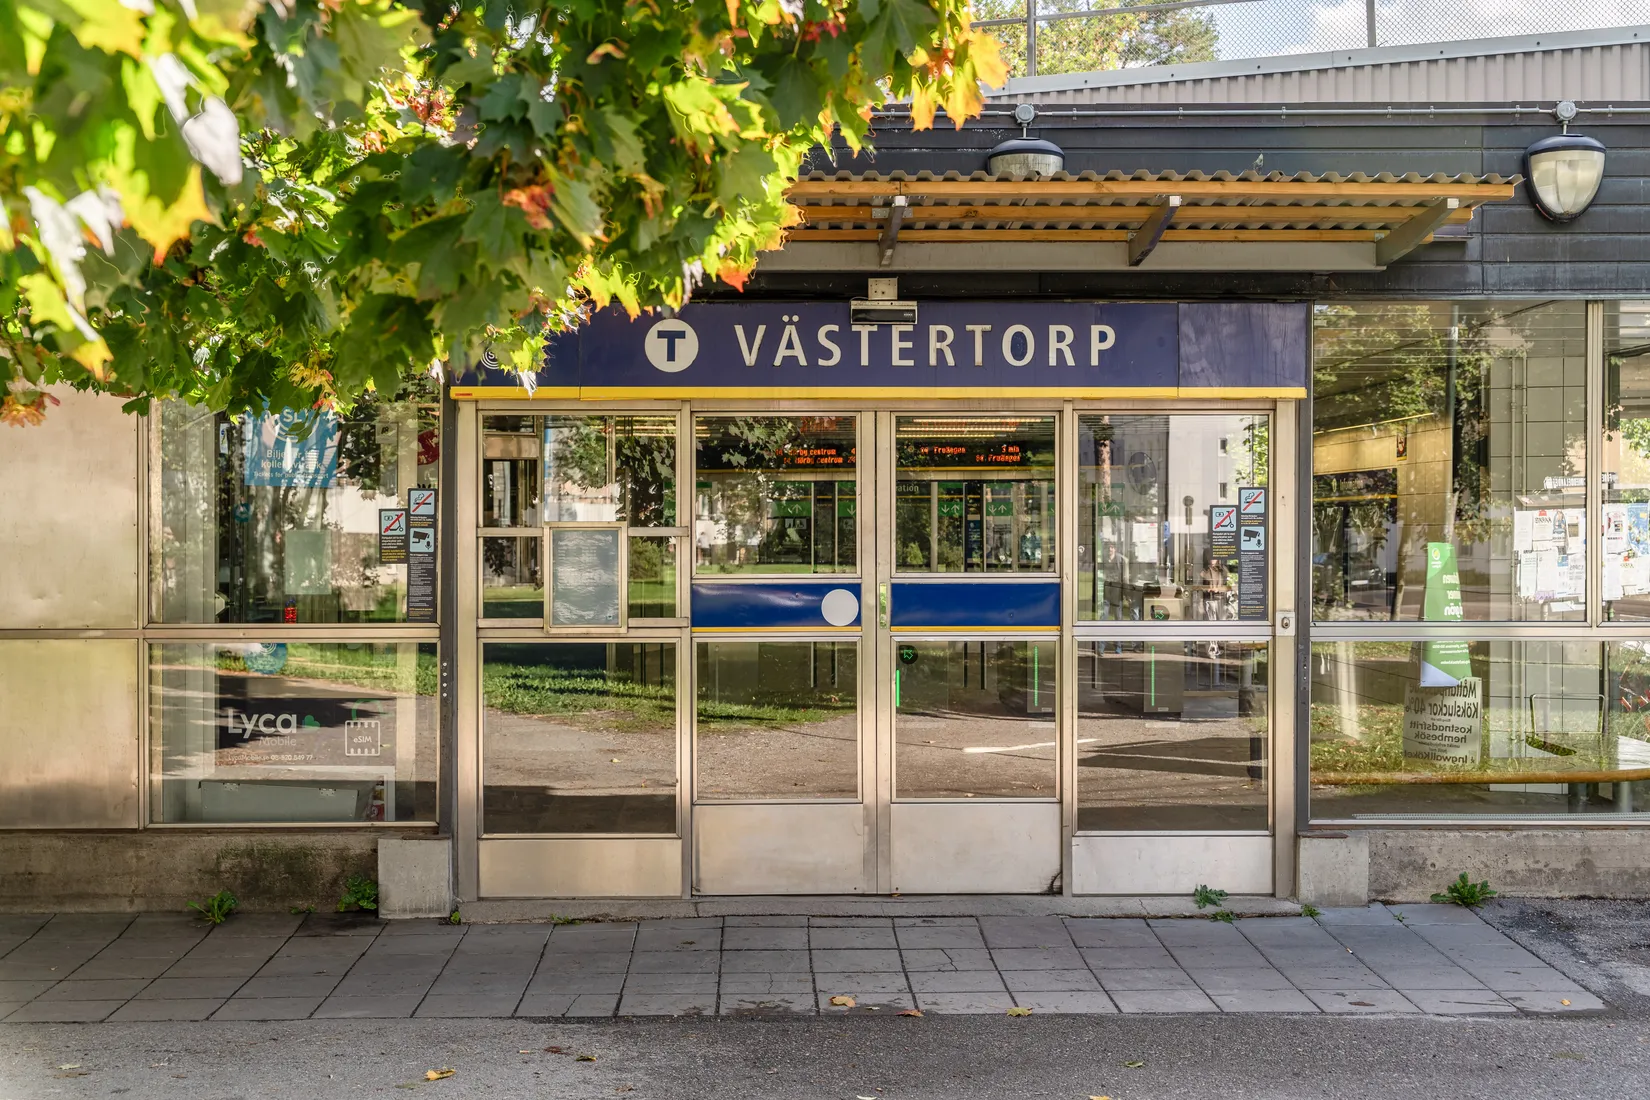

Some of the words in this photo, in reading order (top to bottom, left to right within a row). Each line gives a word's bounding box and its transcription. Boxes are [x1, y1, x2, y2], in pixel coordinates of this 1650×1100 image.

[734, 314, 1117, 367] VÄSTERTORP
[282, 408, 303, 423] SL
[227, 708, 297, 739] Lyca
[258, 735, 297, 747] Mobile
[353, 735, 372, 743] eSIM
